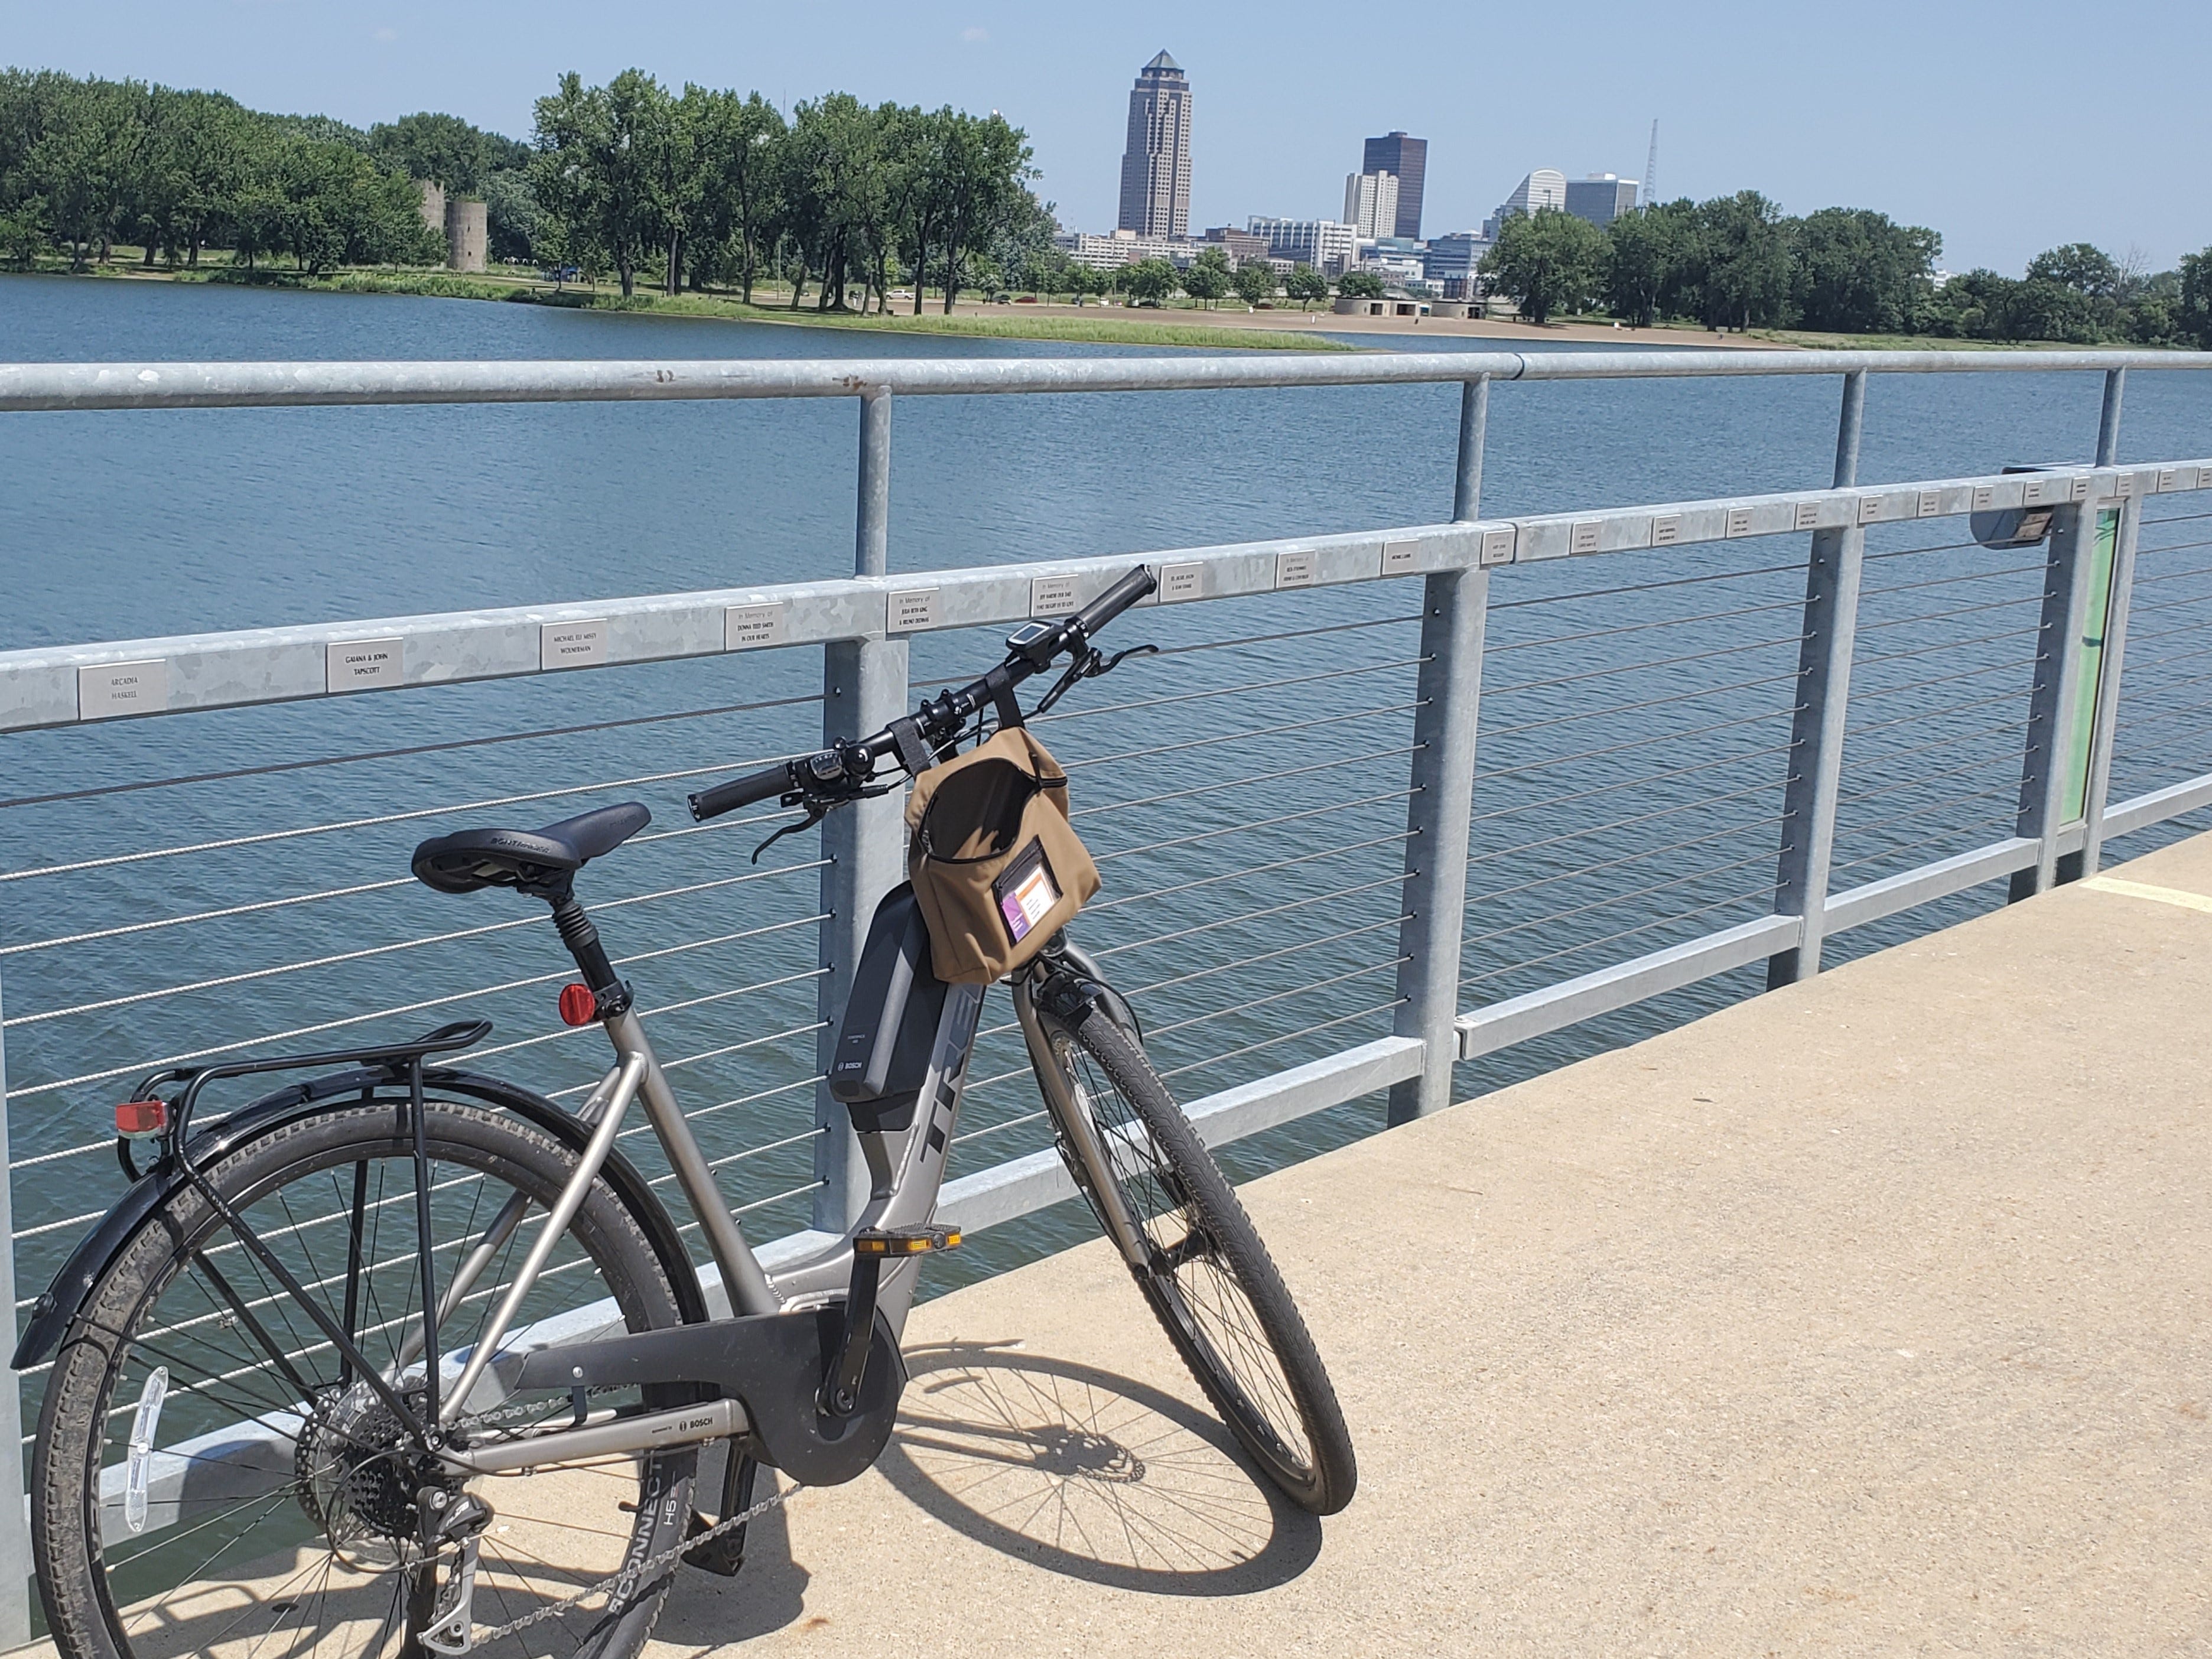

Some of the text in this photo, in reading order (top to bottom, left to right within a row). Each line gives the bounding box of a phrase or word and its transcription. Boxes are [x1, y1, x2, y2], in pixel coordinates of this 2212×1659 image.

[373, 653, 388, 662] JOHN
[354, 666, 380, 675] TAPSCOTT
[112, 676, 138, 686] ARCADIA
[112, 691, 137, 700] HASKELL
[844, 1062, 863, 1070] BOSCH
[689, 1417, 713, 1429] BOSCH
[663, 1499, 677, 1525] H5
